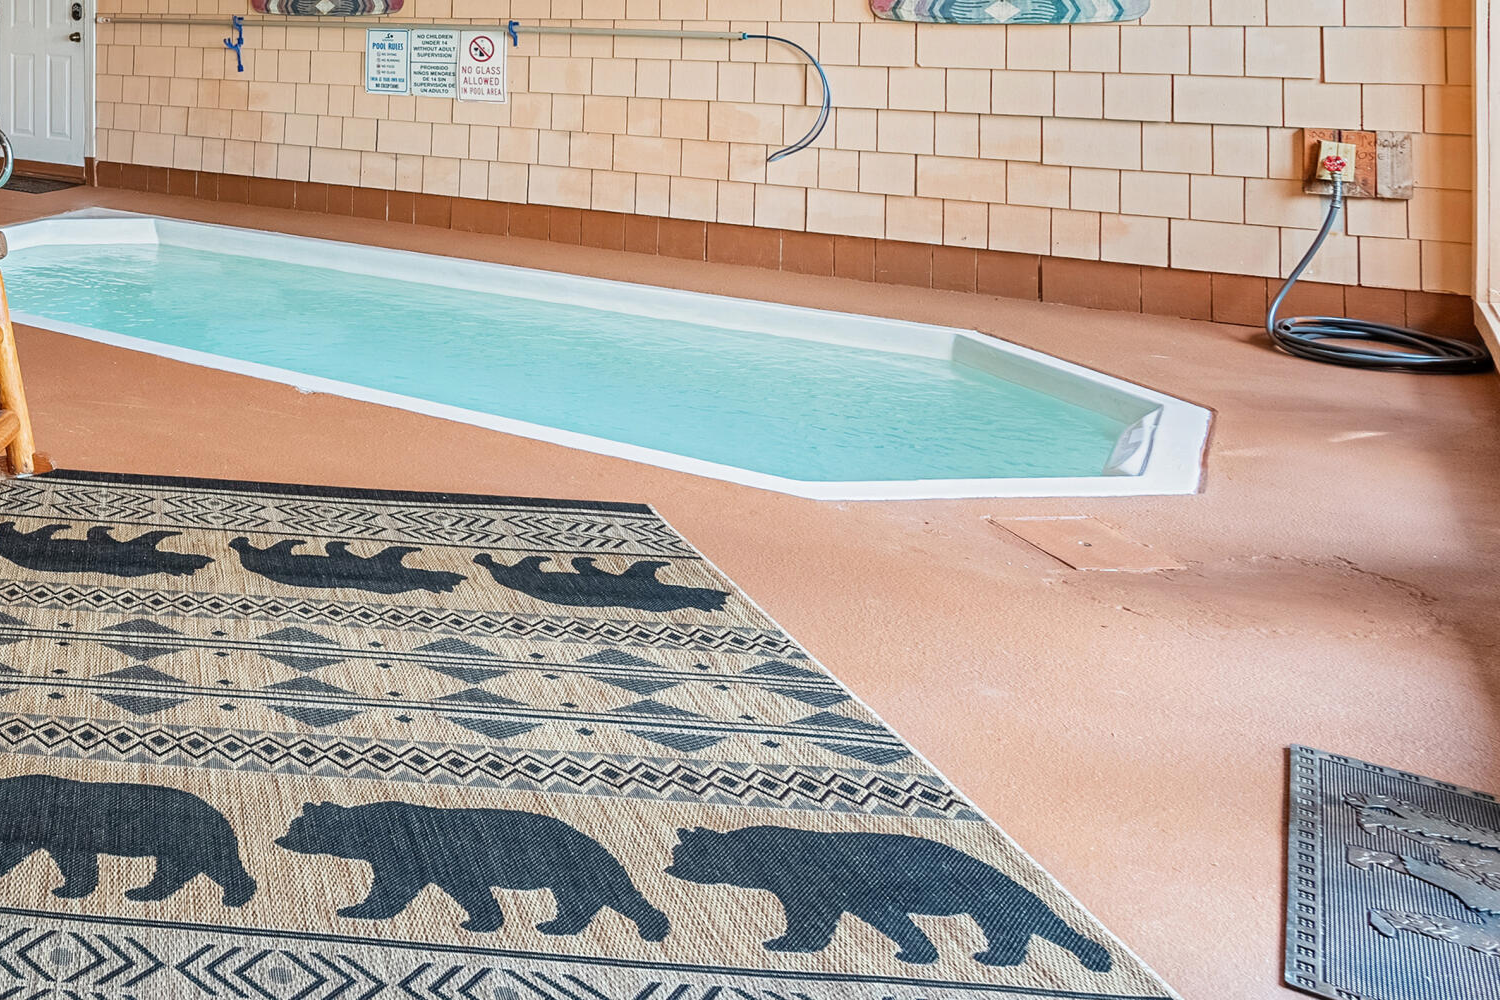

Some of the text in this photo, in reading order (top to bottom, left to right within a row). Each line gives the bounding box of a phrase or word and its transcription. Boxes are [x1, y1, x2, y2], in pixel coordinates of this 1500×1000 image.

[372, 42, 404, 50] POOL RULES
[461, 66, 501, 75] NO GLASS
[463, 76, 500, 85] ALLOWED
[486, 87, 501, 95] AREA
